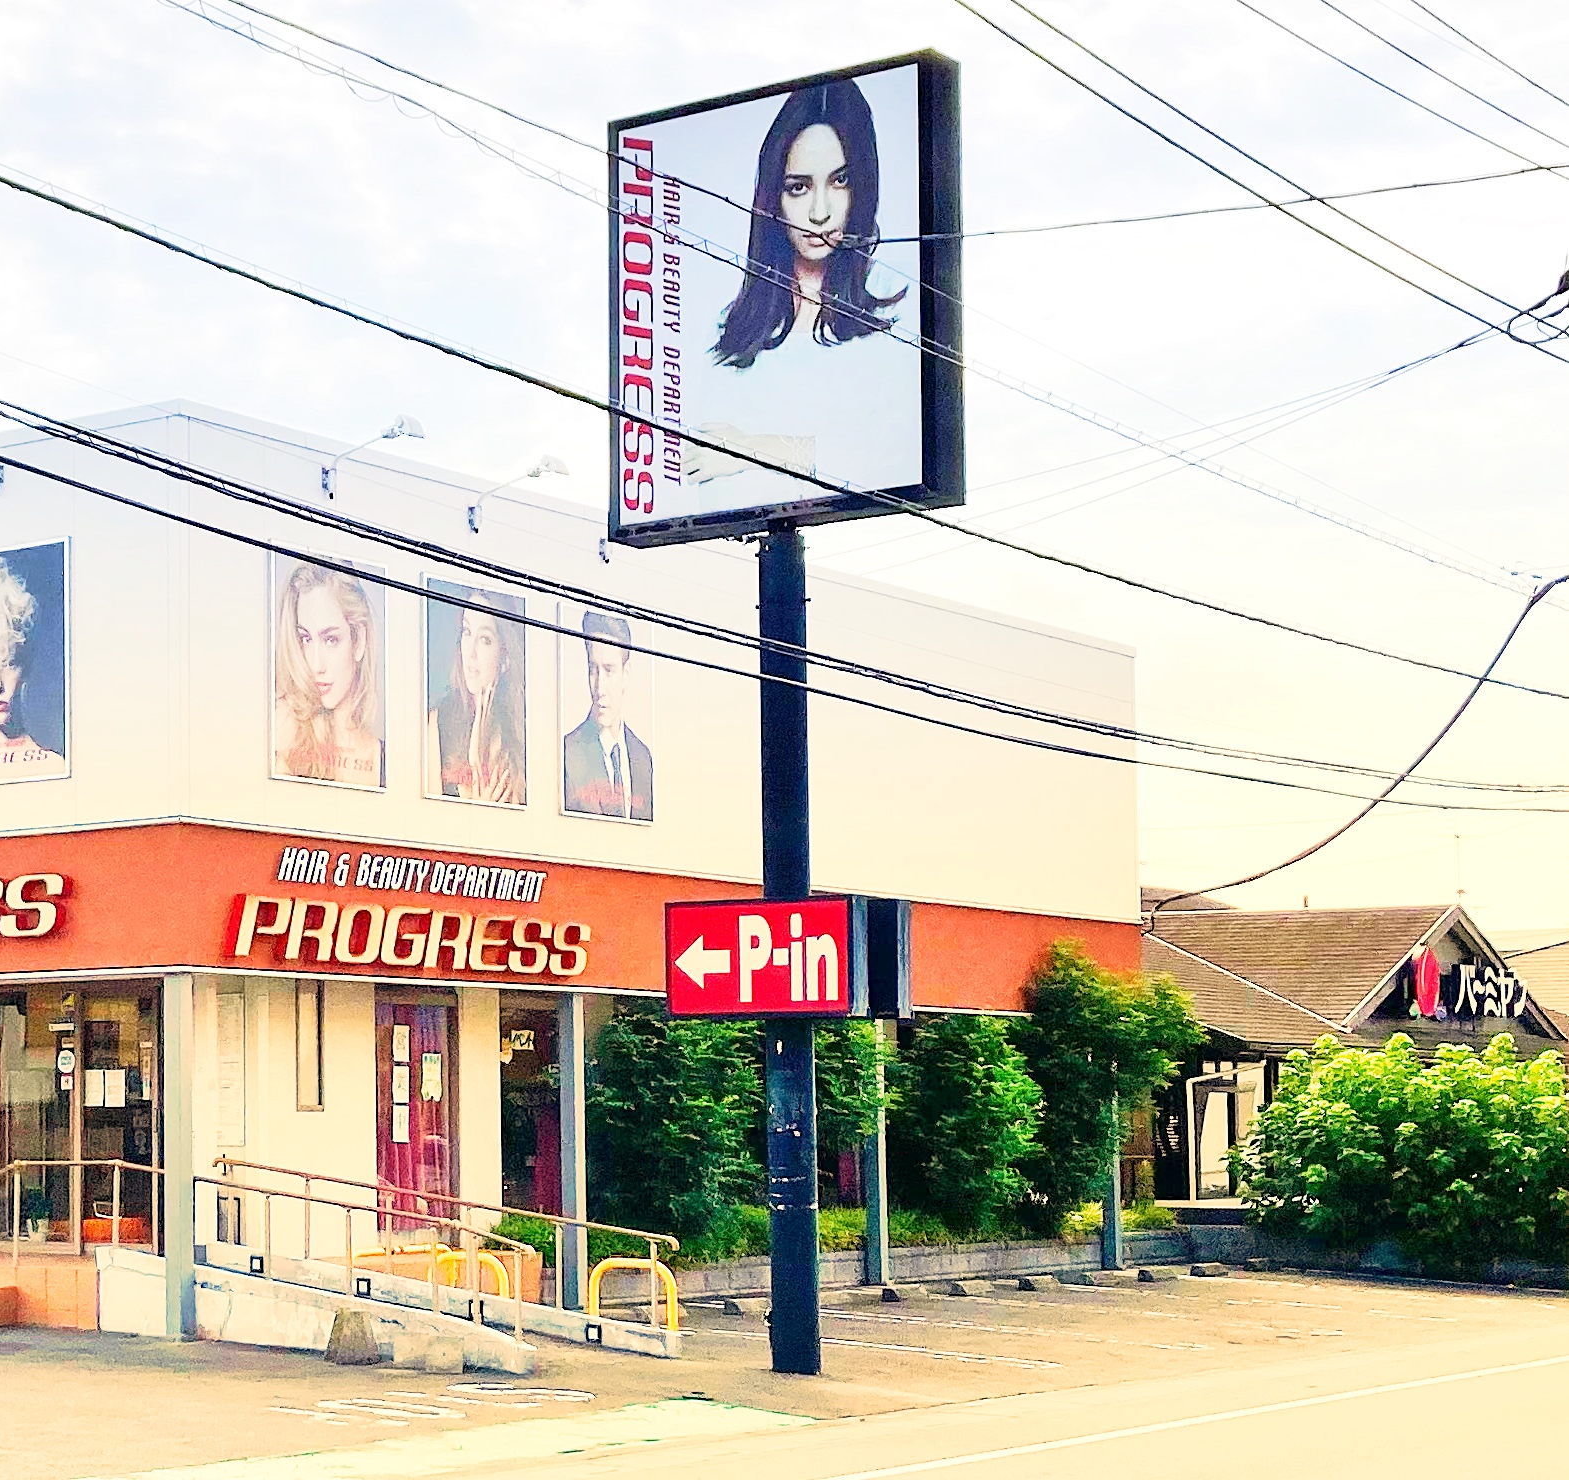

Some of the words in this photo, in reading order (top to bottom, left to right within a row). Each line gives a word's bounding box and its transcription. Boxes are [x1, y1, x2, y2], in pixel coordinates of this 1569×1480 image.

[663, 173, 680, 225] HAIR
[623, 137, 654, 513] PROGRESS
[663, 253, 680, 333] BEAUTY
[663, 346, 681, 486] DEPARTMENT
[278, 847, 330, 884] HAIR
[333, 853, 350, 887] &
[355, 853, 430, 893] BEAUTY
[430, 861, 547, 902] DEPARTMENT
[234, 895, 592, 977] PROGRESS
[738, 912, 839, 1003] P-in
[1454, 956, 1529, 1018] バーミヤン
